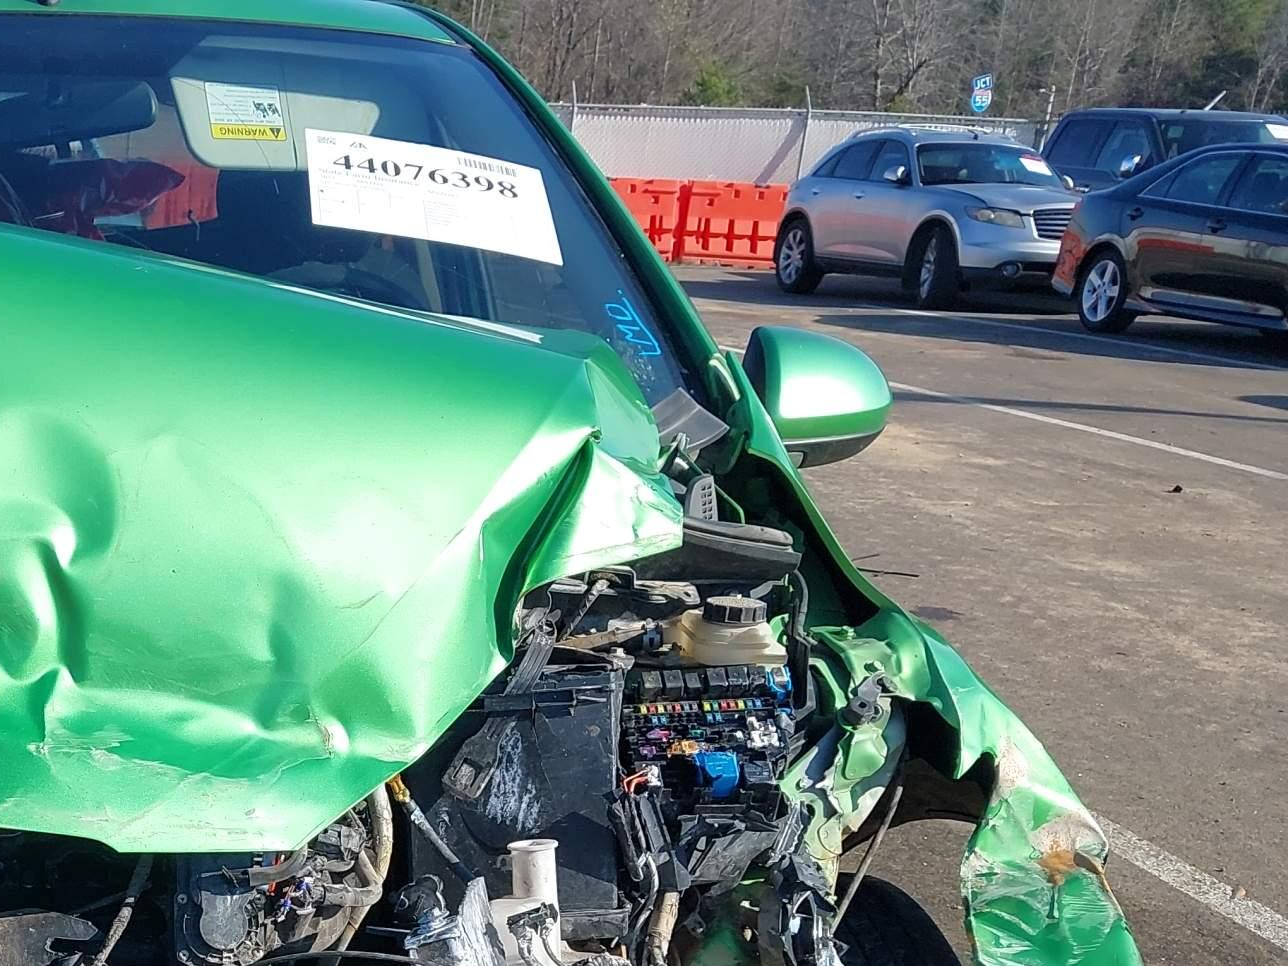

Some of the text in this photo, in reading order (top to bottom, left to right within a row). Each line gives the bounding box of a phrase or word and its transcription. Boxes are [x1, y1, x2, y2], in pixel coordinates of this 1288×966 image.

[975, 77, 991, 90] JCT
[975, 95, 988, 106] 55
[219, 126, 269, 137] WARNING
[332, 154, 519, 199] 44076398
